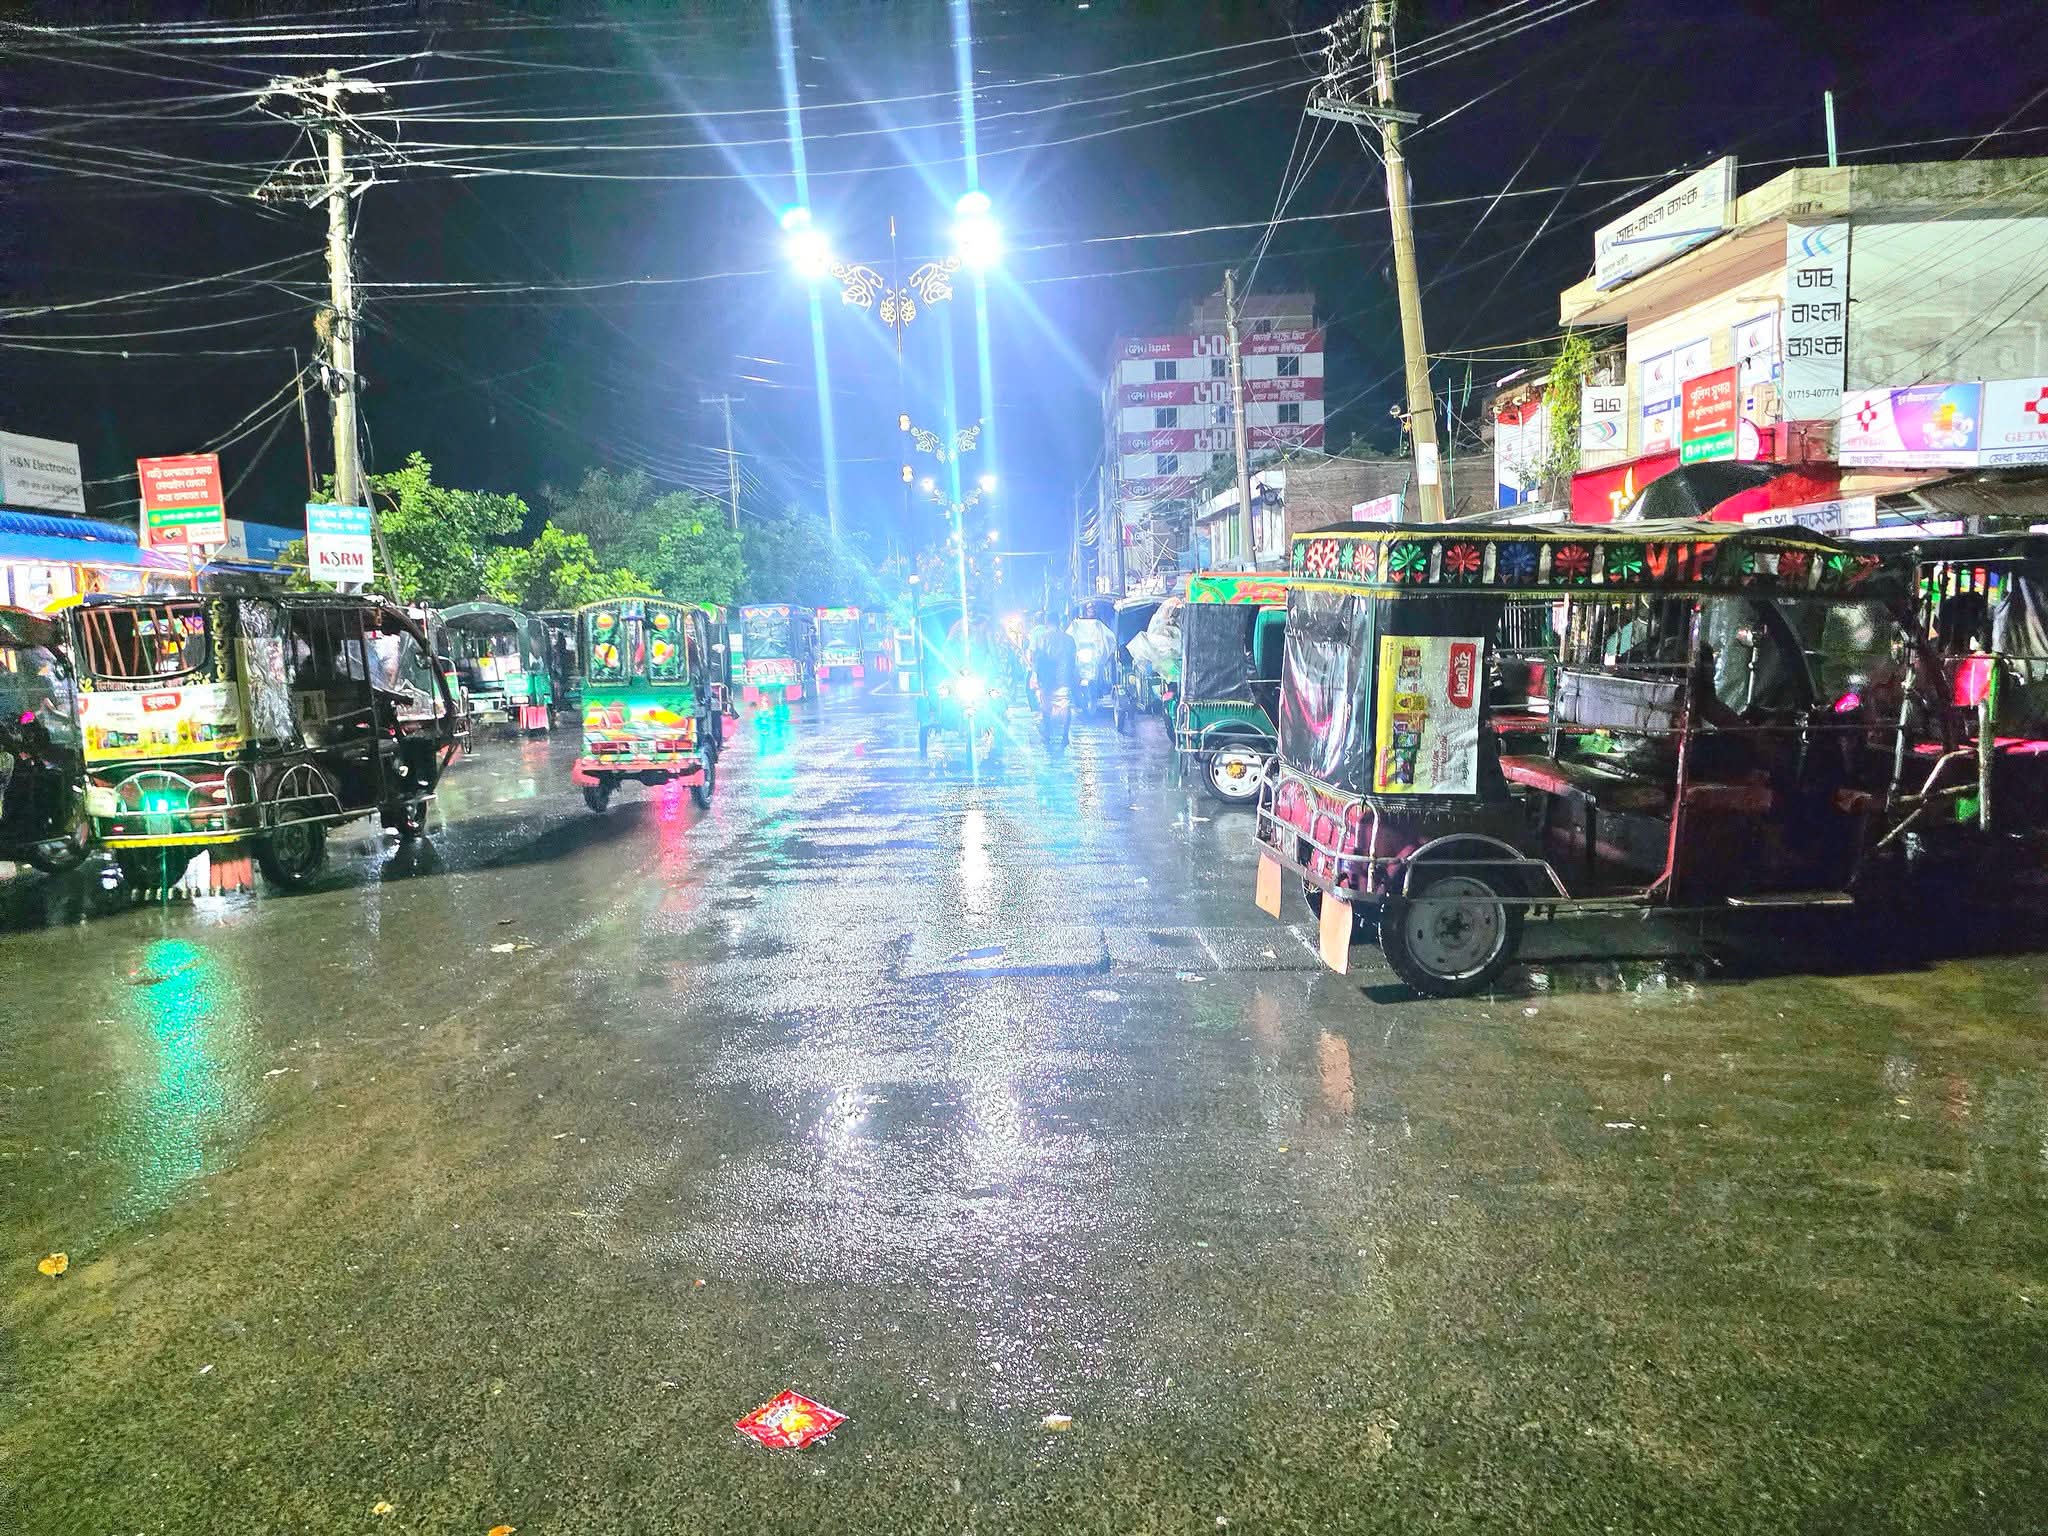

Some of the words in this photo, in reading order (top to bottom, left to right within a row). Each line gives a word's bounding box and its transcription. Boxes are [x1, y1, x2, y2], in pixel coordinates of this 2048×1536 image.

[1667, 187, 1698, 216] ব্যাংক
[1792, 302, 1841, 323] বাংলা
[1788, 336, 1843, 357] ব্যাংক
[1788, 388, 1840, 400] 01715-407774
[32, 458, 77, 475] Electronics
[320, 551, 363, 567] KSRM
